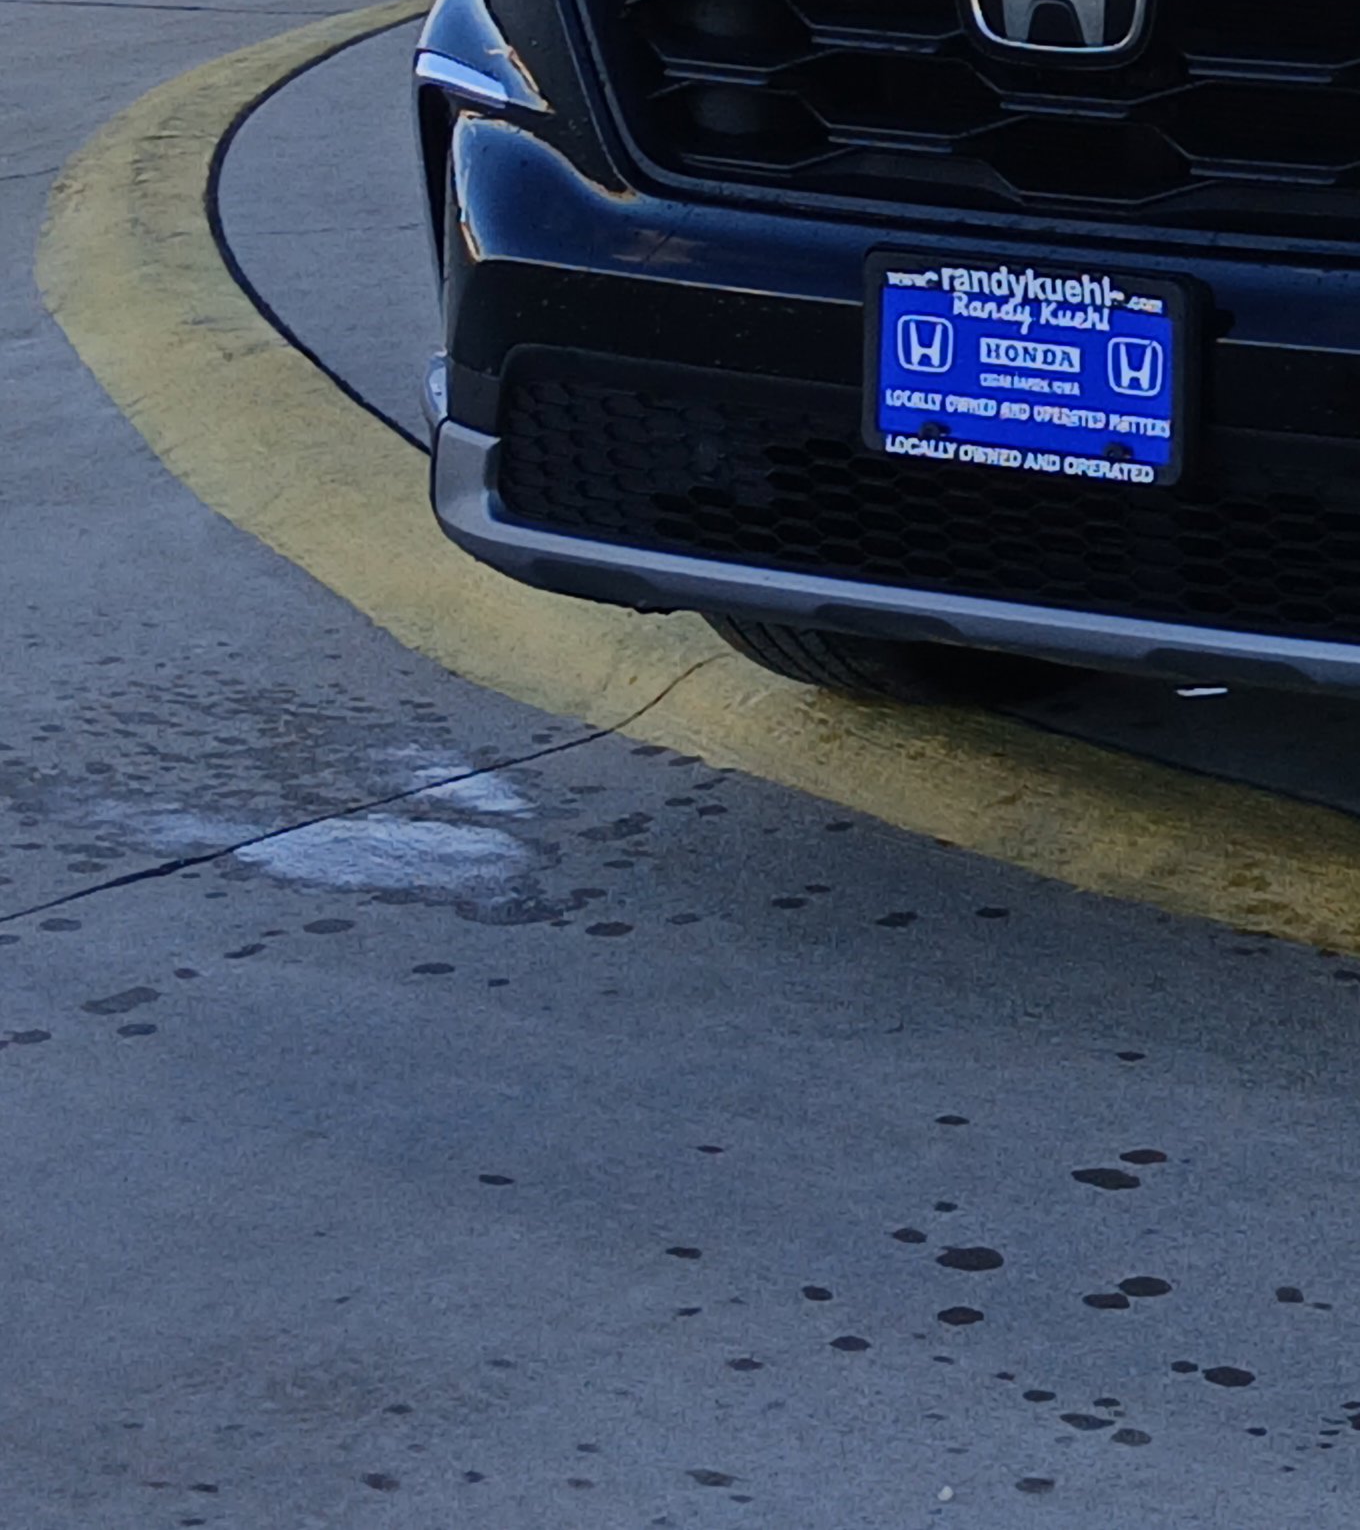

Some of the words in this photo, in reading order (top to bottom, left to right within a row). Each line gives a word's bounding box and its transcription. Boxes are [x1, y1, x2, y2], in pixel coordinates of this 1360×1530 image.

[953, 291, 1033, 335] Randy
[1040, 301, 1111, 331] Kuehl
[985, 342, 1075, 369] HONDA
[886, 388, 942, 411] LOCALLY
[886, 434, 957, 460] LOCALLY
[959, 444, 1022, 468] OWNED
[1023, 452, 1060, 472] AND
[1063, 456, 1154, 483] OPERATED
